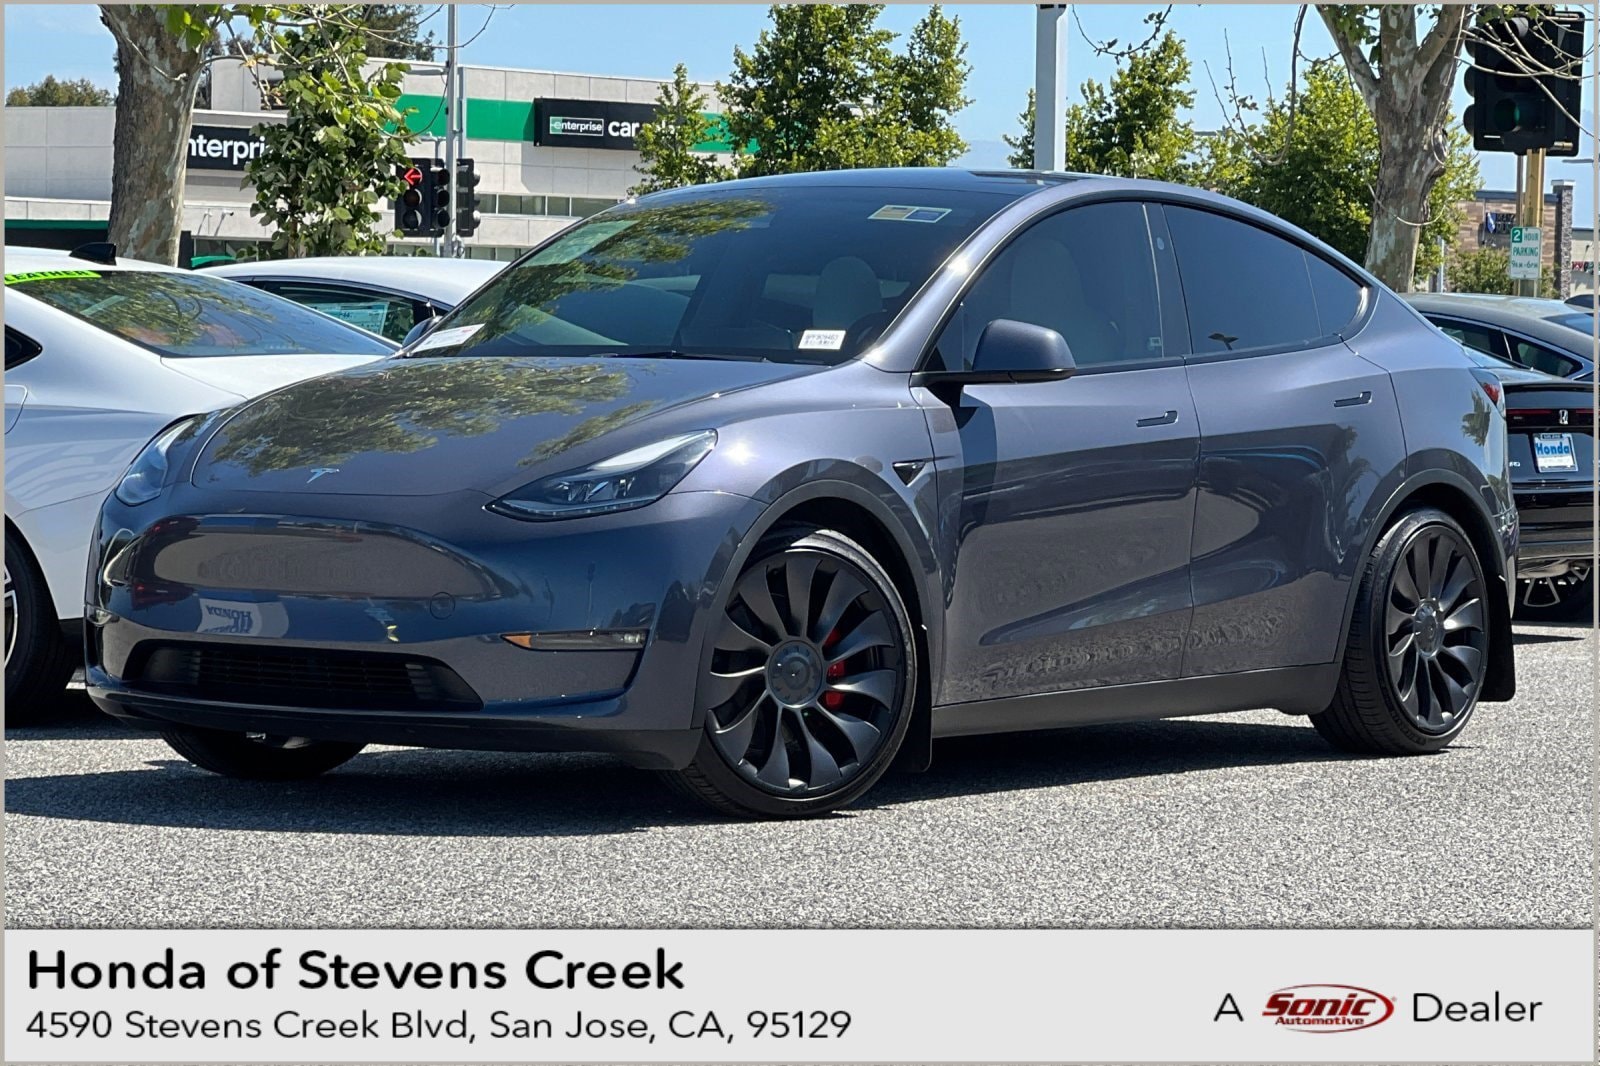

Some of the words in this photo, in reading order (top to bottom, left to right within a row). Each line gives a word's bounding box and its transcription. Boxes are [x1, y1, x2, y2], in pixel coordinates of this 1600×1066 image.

[552, 120, 602, 133] enterprise
[608, 121, 640, 137] car
[187, 134, 266, 165] nterpri
[1513, 229, 1521, 242] 2
[1523, 232, 1539, 241] HOUR
[1512, 247, 1539, 257] PARKING
[1535, 441, 1570, 455] Honda
